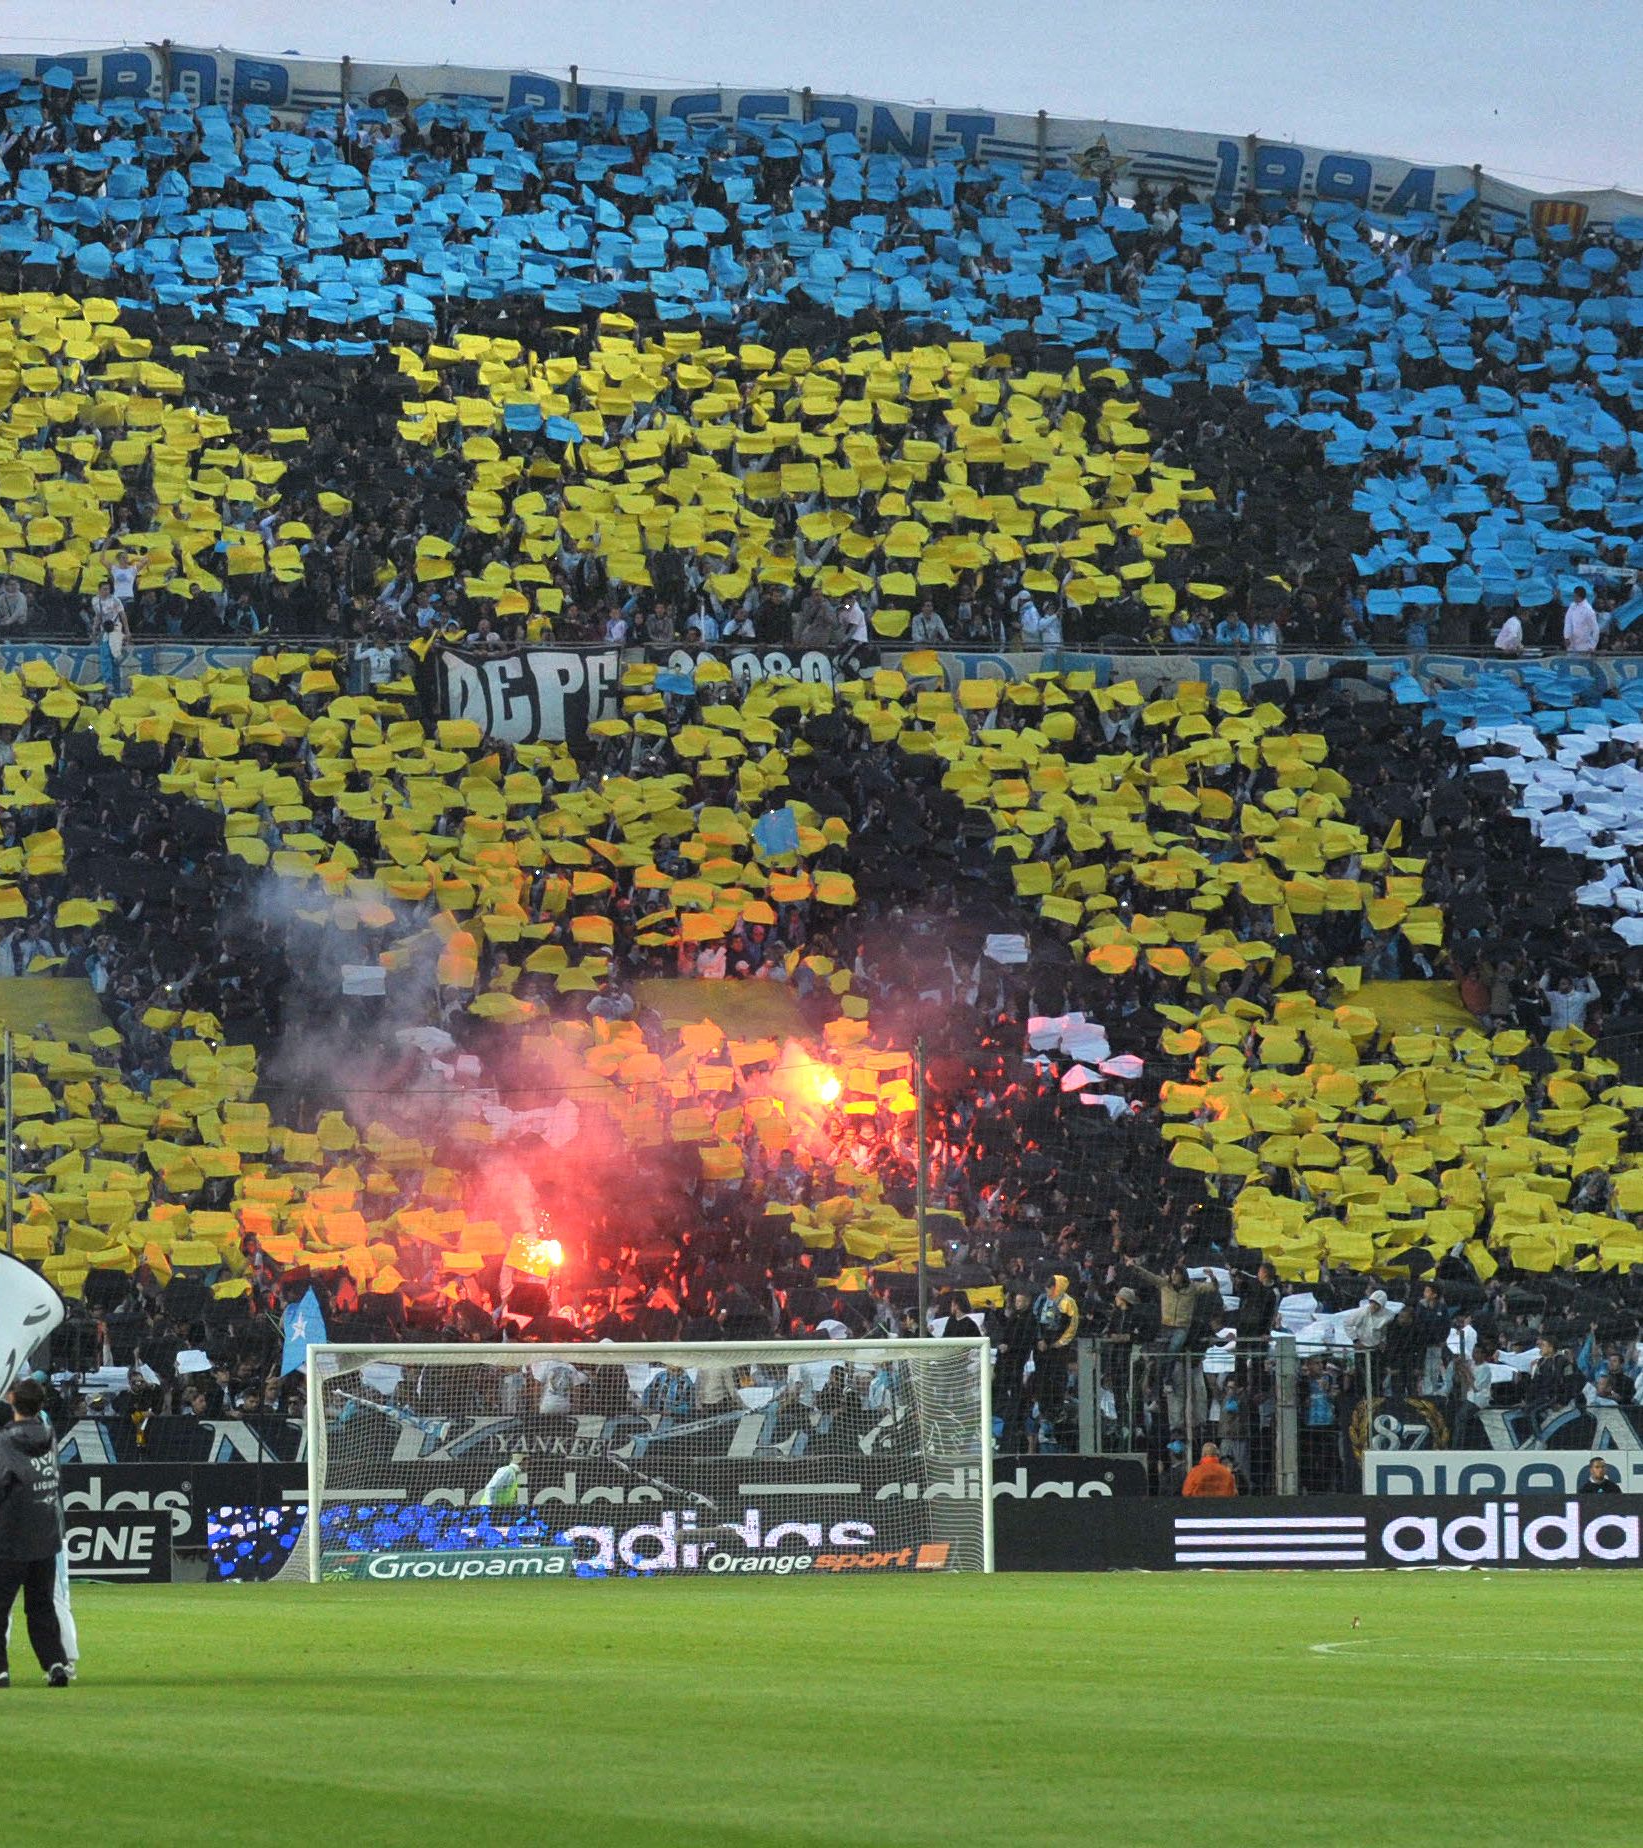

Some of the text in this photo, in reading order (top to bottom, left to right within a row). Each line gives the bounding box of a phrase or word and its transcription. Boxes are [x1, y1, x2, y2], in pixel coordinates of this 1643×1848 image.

[1214, 138, 1436, 214] 1994
[1371, 1414, 1430, 1450] 87
[367, 1555, 566, 1582] Groupama
[707, 1546, 914, 1575] Orange sport
